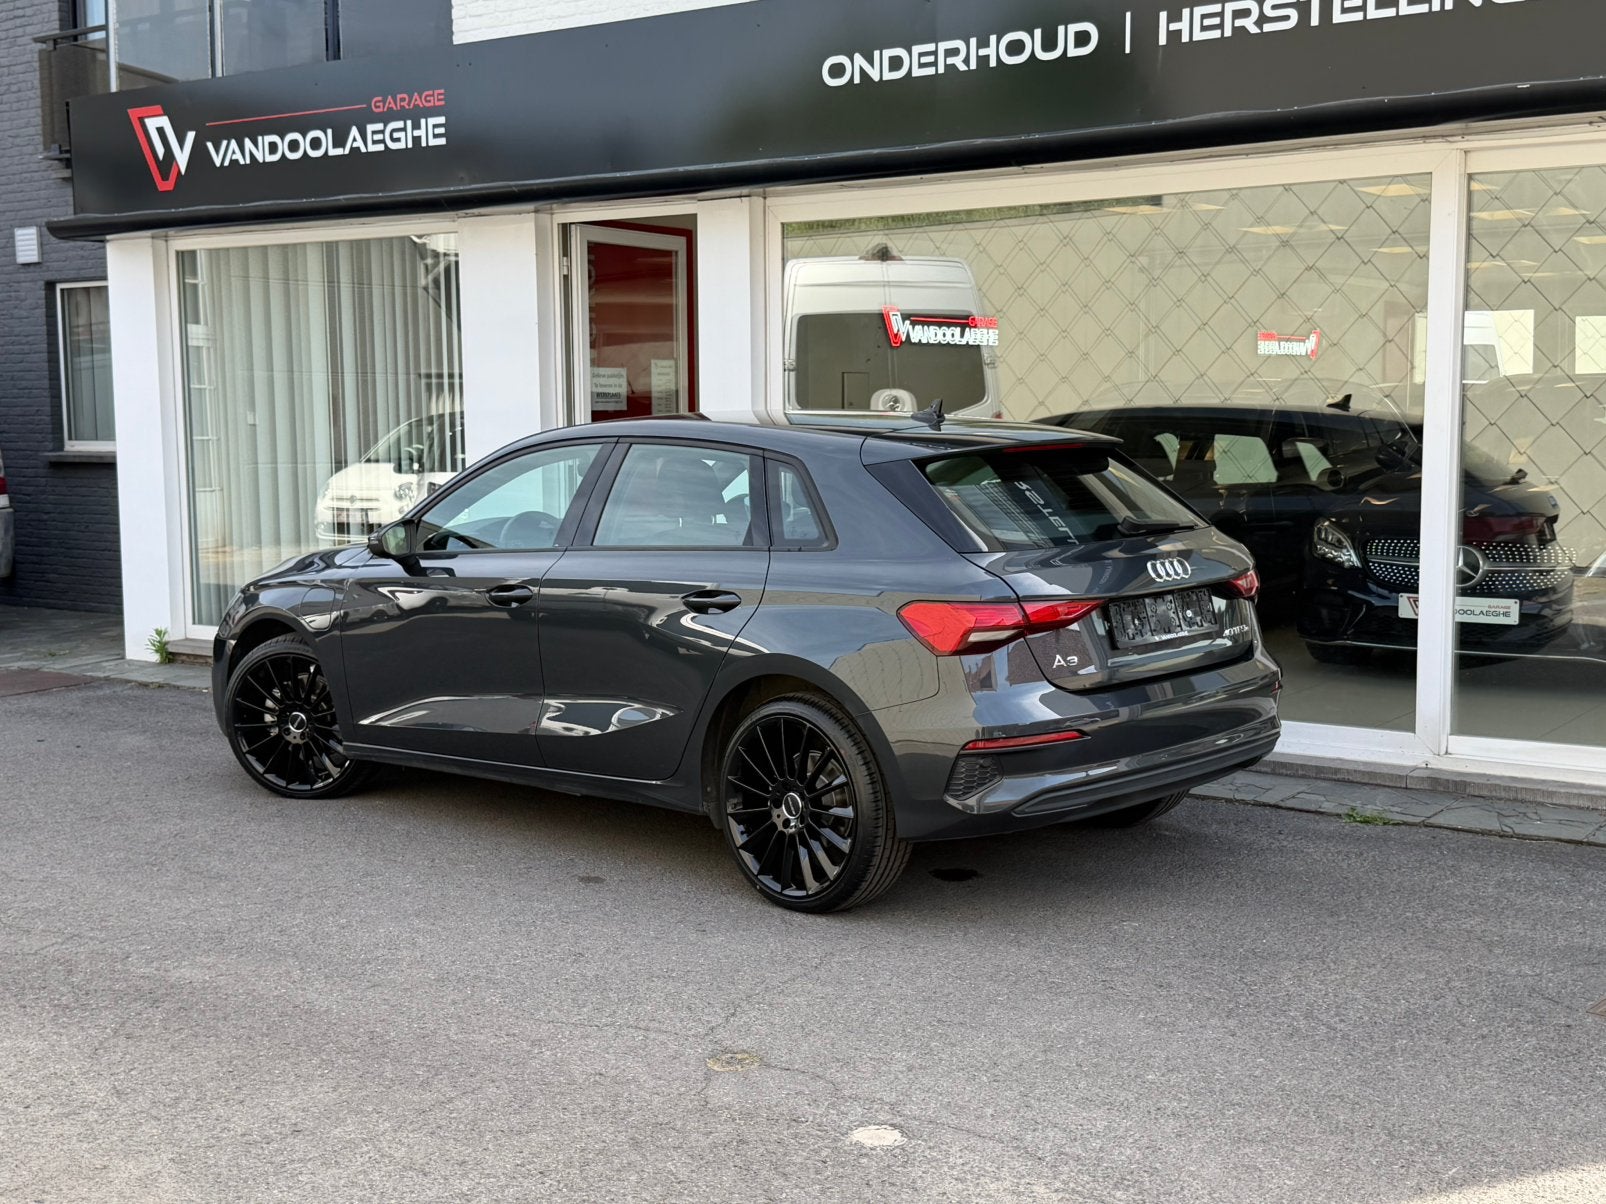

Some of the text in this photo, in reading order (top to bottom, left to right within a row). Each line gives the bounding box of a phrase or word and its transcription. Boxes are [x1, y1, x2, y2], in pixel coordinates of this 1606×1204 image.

[821, 0, 1527, 87] ONDERHOUD HERSTELL
[371, 89, 445, 113] GARAGE
[206, 115, 447, 168] VANDOOLAEGHE
[1053, 654, 1078, 669] A3
